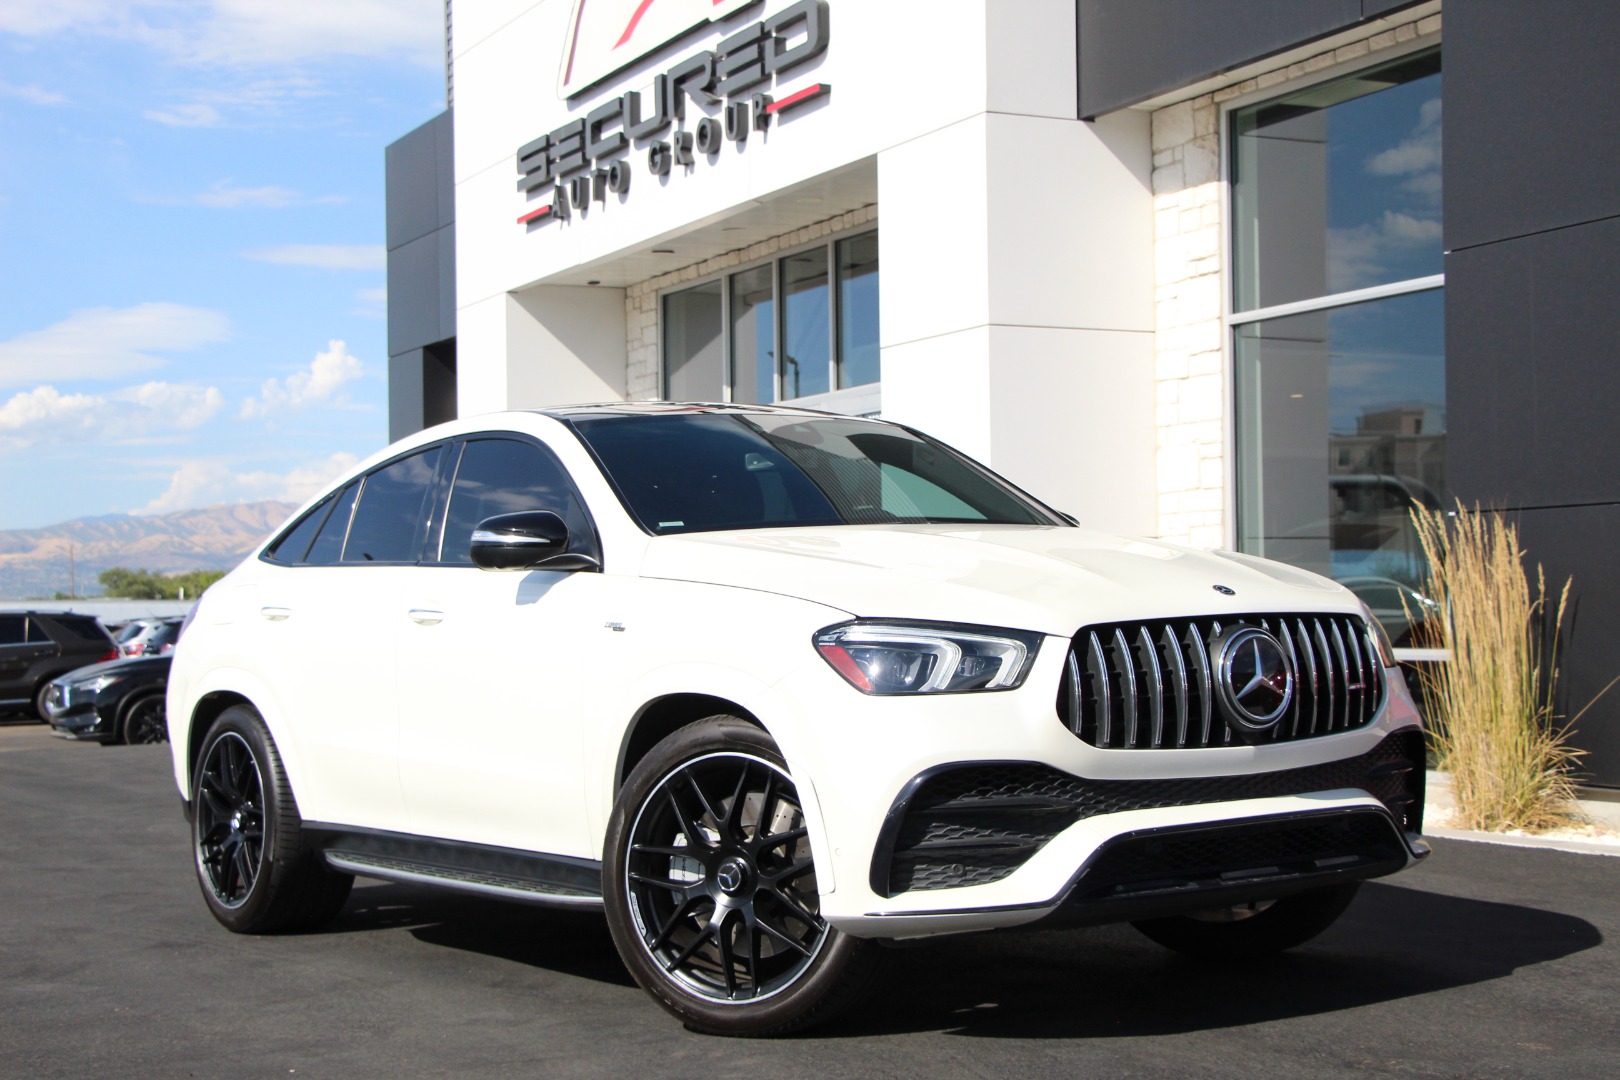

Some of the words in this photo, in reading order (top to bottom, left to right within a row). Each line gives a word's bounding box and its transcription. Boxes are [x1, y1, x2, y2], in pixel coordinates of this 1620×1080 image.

[516, 0, 830, 193] SECURED
[552, 159, 631, 221] AUTO
[648, 93, 775, 176] GROUP
